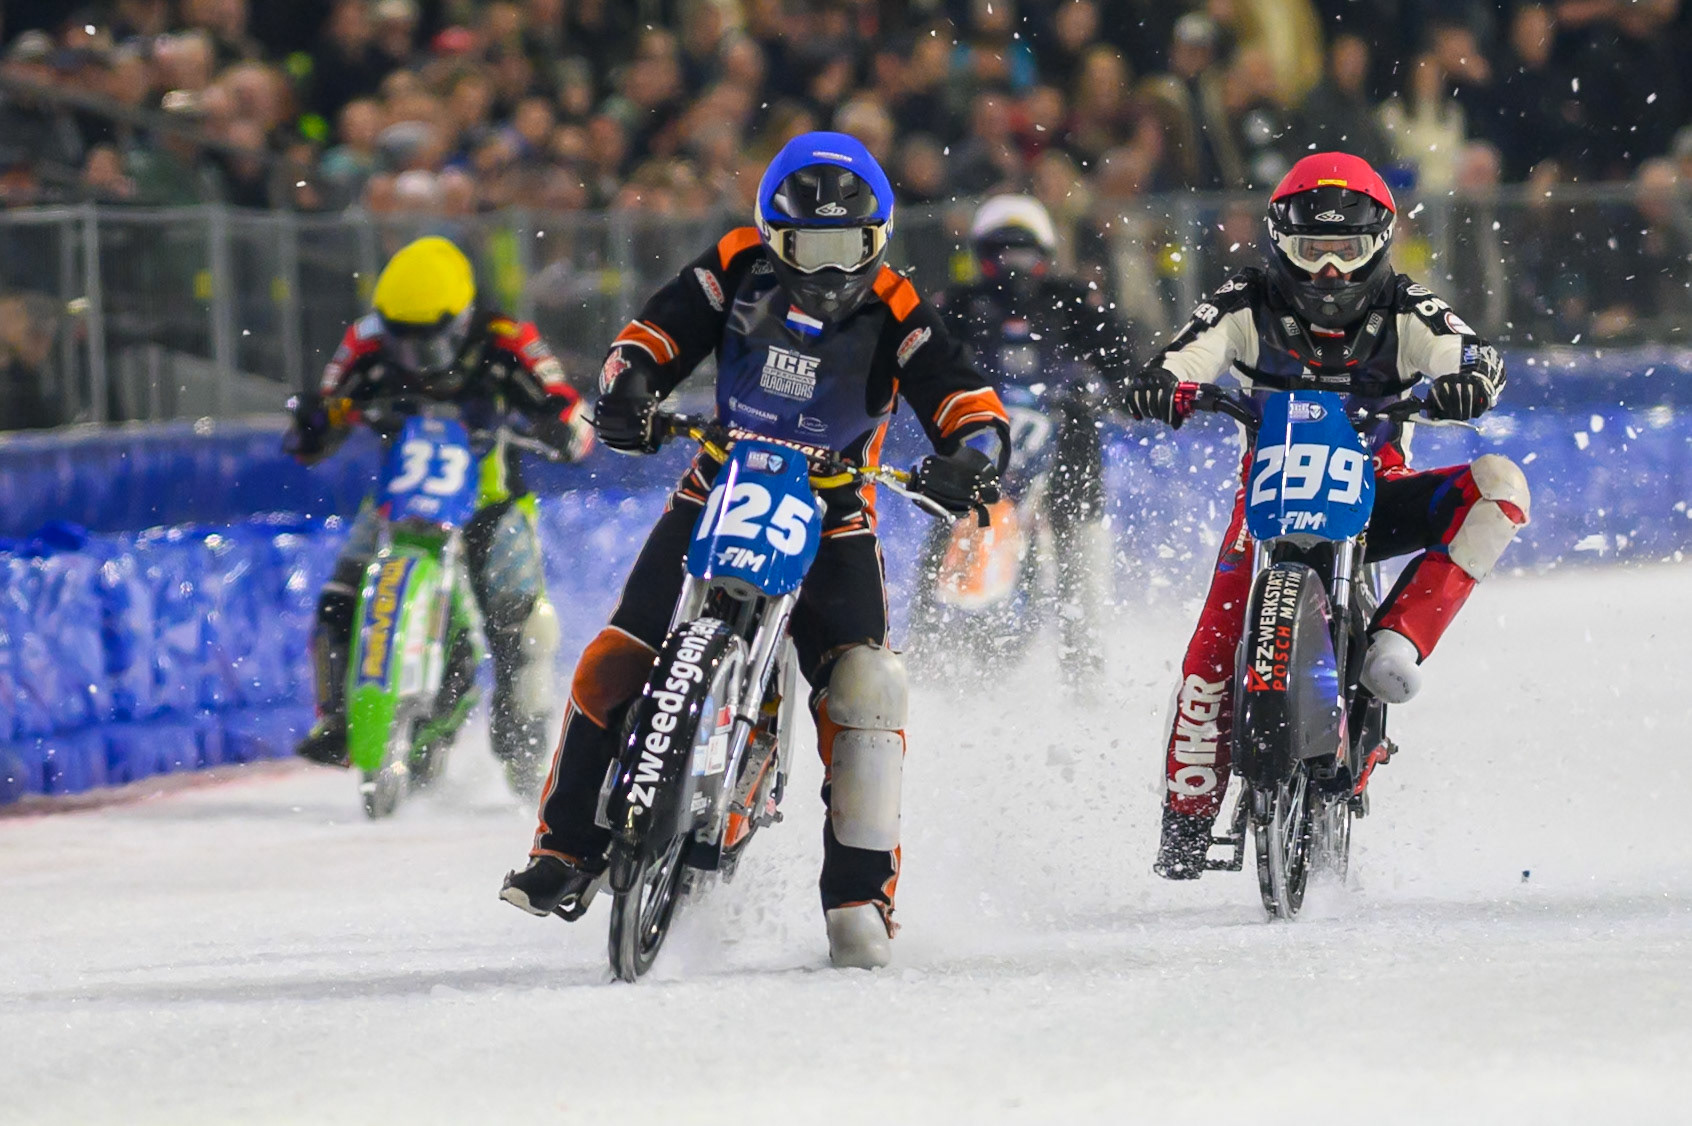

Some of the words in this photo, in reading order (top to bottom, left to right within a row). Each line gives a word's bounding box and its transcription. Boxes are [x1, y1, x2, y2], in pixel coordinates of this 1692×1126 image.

[766, 345, 821, 378] ICE
[388, 440, 470, 495] 33
[1251, 443, 1364, 507] 299
[696, 482, 815, 556] 125
[1278, 511, 1324, 530] FIM
[716, 546, 766, 572] FIM
[1280, 571, 1302, 620] MARTIN
[1272, 625, 1291, 692] POSCH
